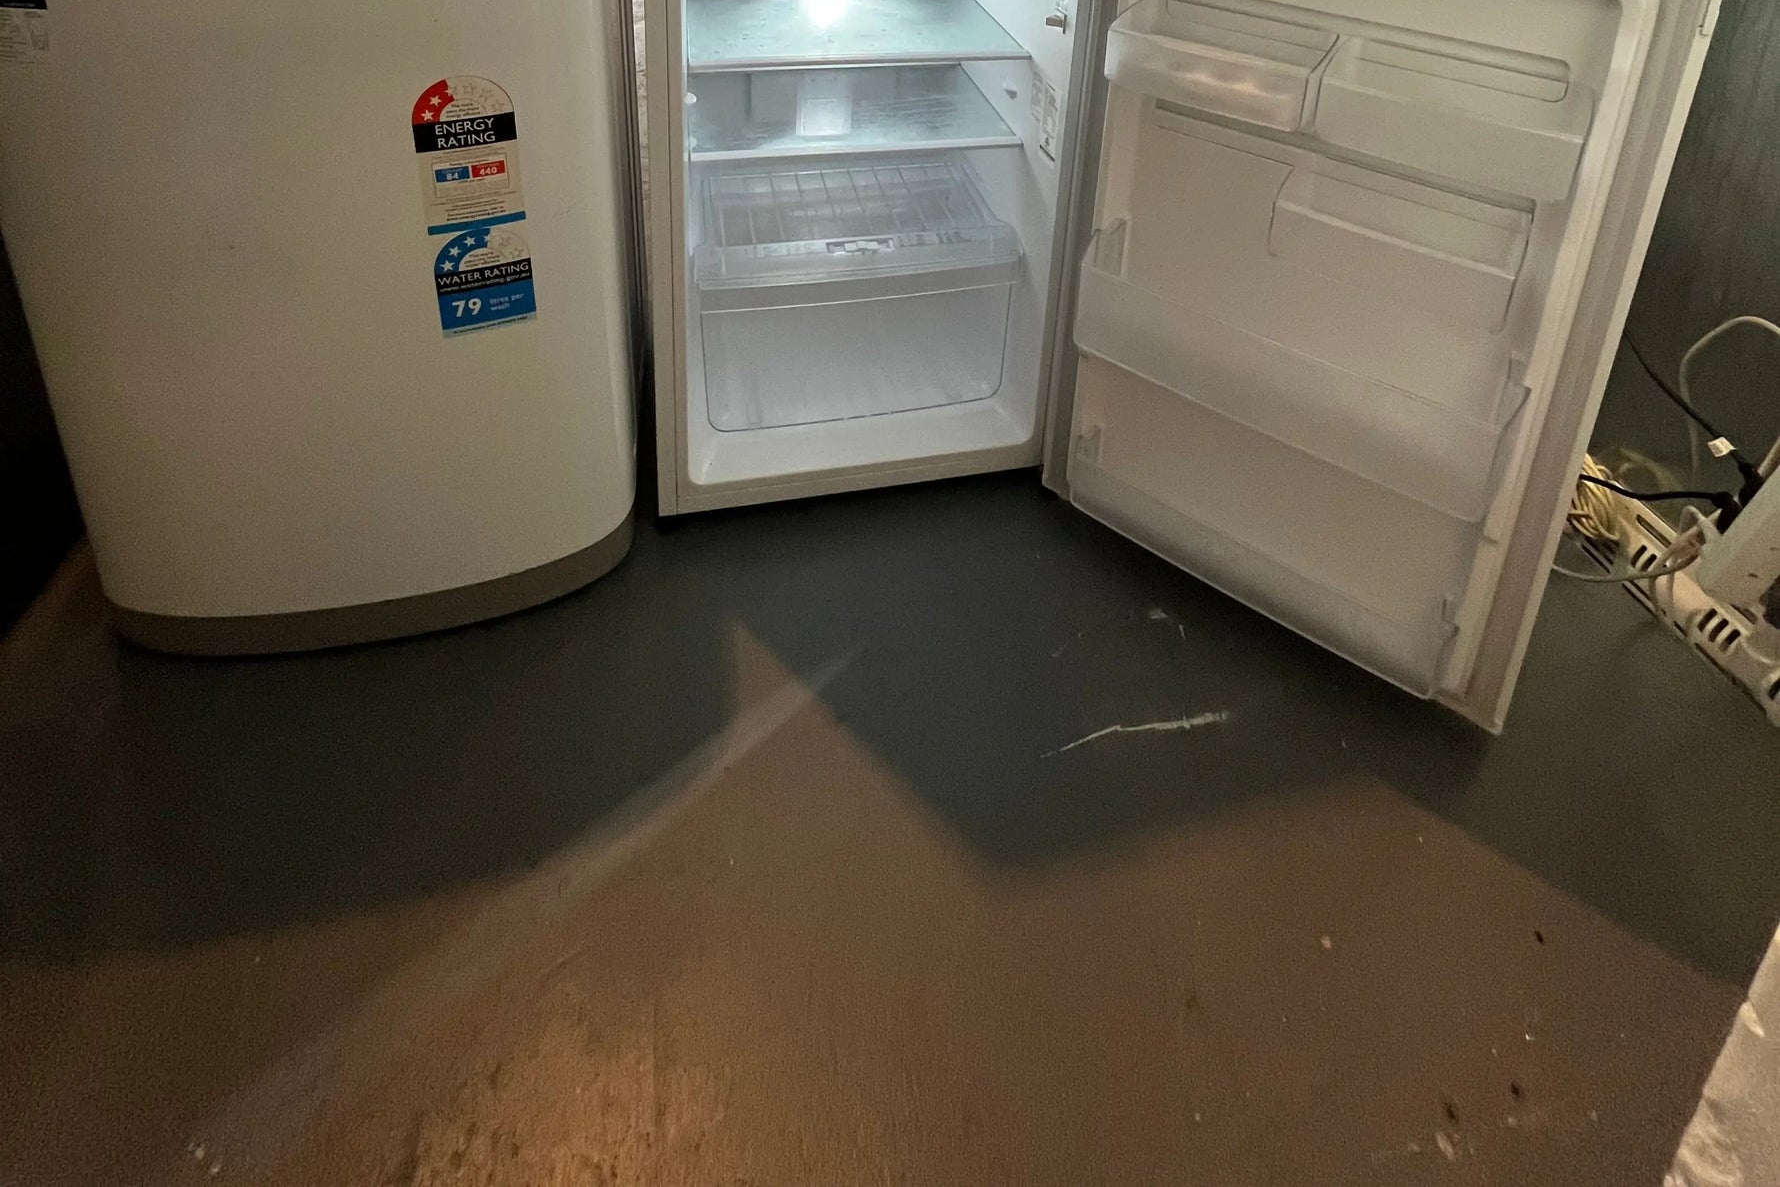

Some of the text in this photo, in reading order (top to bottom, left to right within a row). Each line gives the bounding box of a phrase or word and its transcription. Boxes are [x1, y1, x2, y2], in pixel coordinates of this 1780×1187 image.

[434, 117, 495, 135] ENERGY
[437, 131, 496, 149] RATING
[446, 172, 459, 181] 84
[479, 166, 498, 176] 440
[437, 262, 529, 286] WATER RATING
[451, 297, 482, 318] 79
